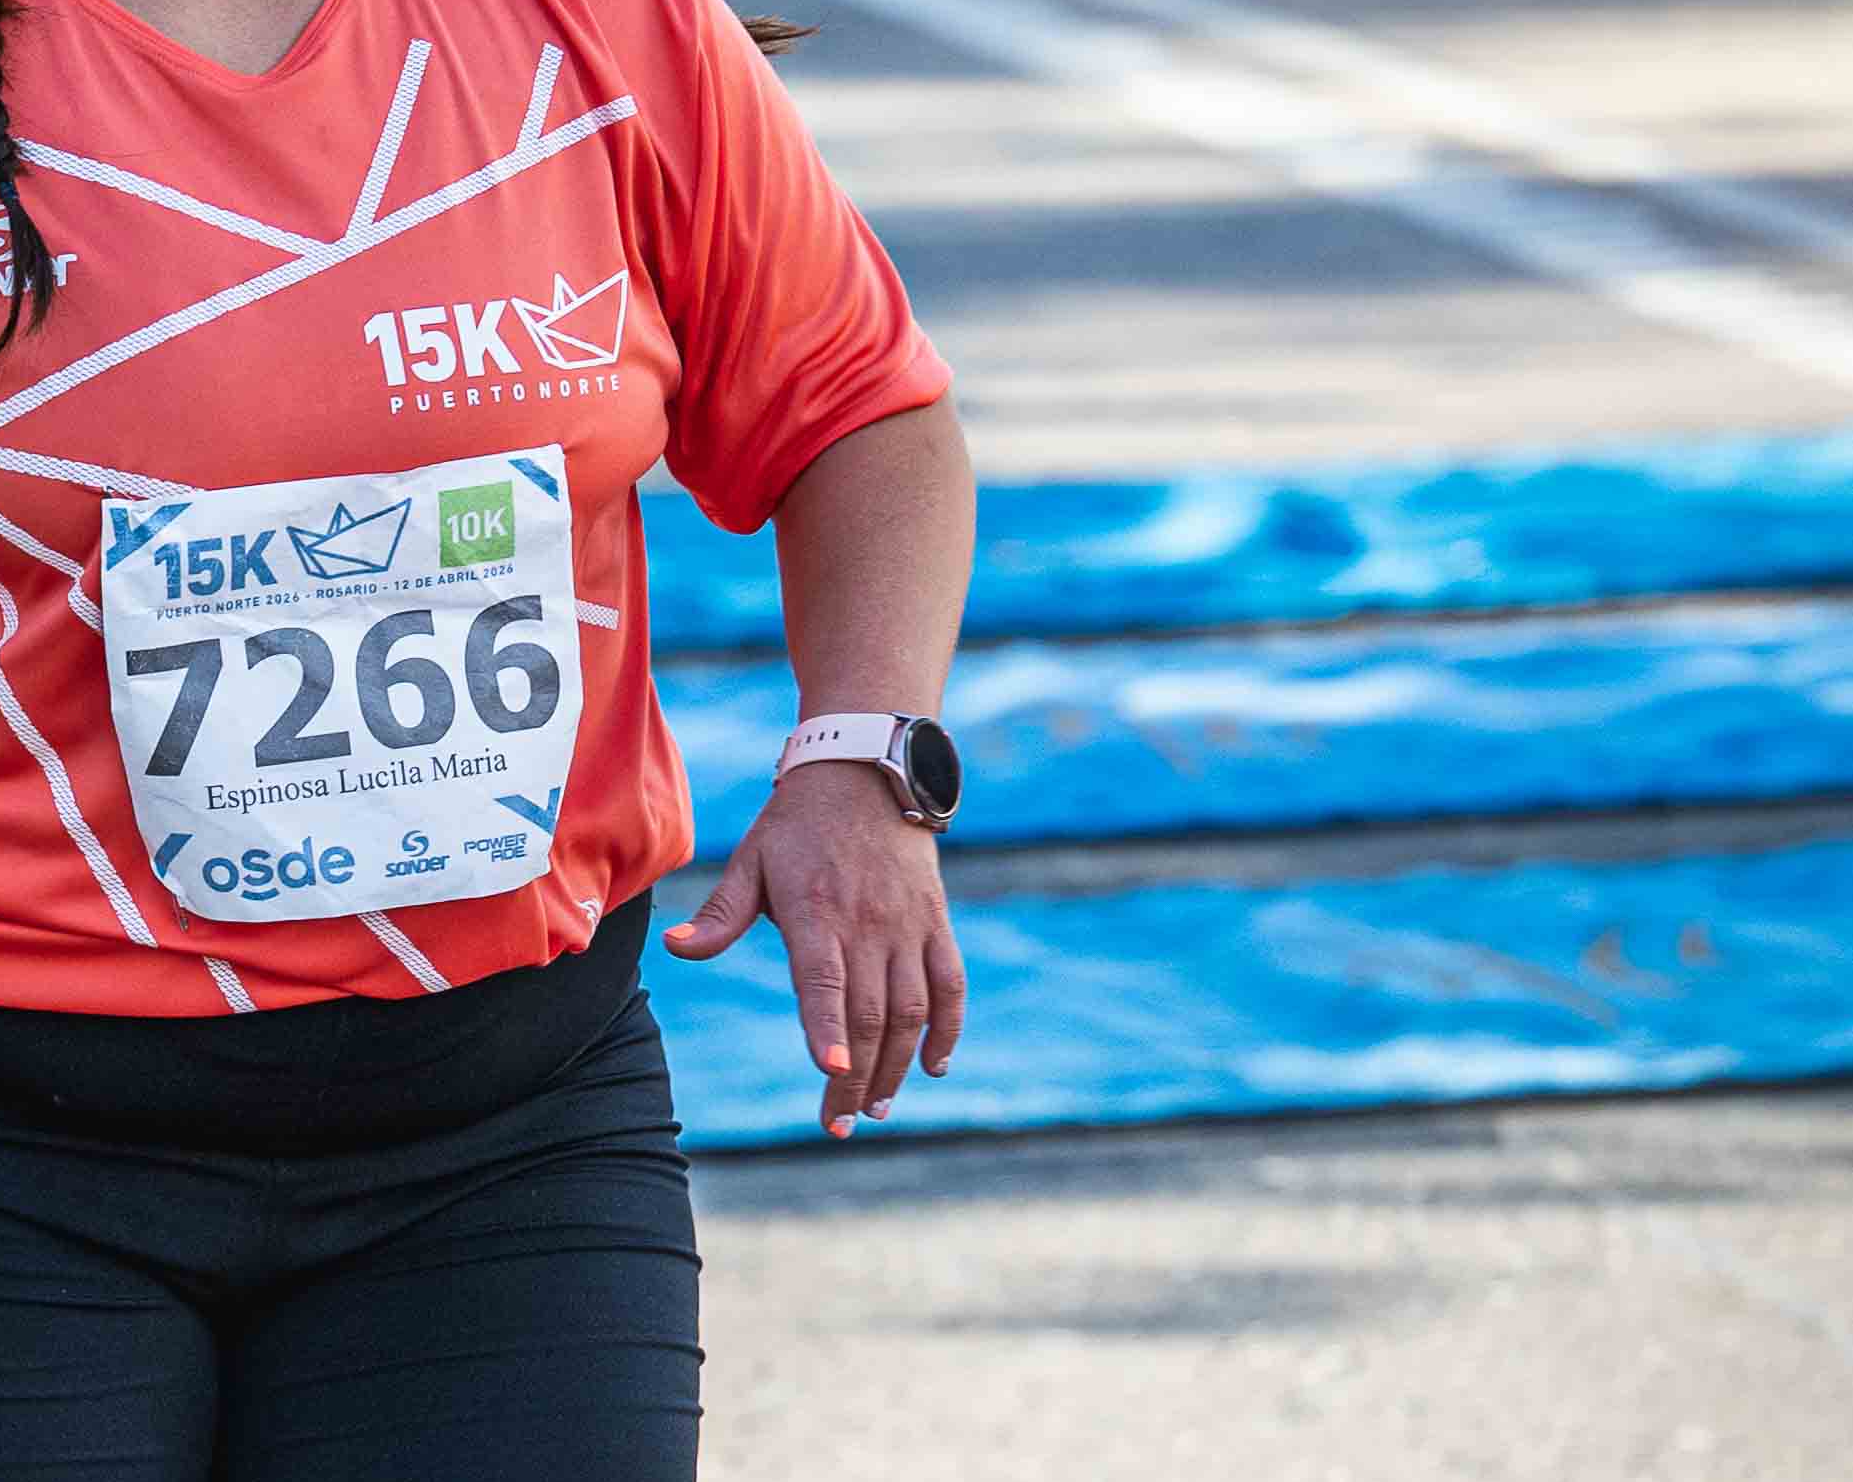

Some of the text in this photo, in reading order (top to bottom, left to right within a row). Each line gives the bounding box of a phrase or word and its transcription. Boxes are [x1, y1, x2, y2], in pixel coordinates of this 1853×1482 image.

[363, 299, 523, 387] 15K
[389, 374, 621, 415] PUERTO NORTE
[447, 506, 509, 544] 10K
[153, 530, 278, 600] 15K
[157, 603, 211, 621] PUERTO
[215, 596, 260, 613] NORTE
[266, 592, 300, 606] 2026
[316, 583, 377, 599] ROSARIO
[394, 579, 409, 591] 12
[415, 576, 433, 589] DE
[437, 570, 478, 586] ABRIL
[483, 565, 514, 578] 2026
[127, 595, 561, 777] 7266
[204, 748, 509, 815] Espinosa Lucila Maria
[202, 836, 355, 894] osde
[464, 832, 527, 854] POWER
